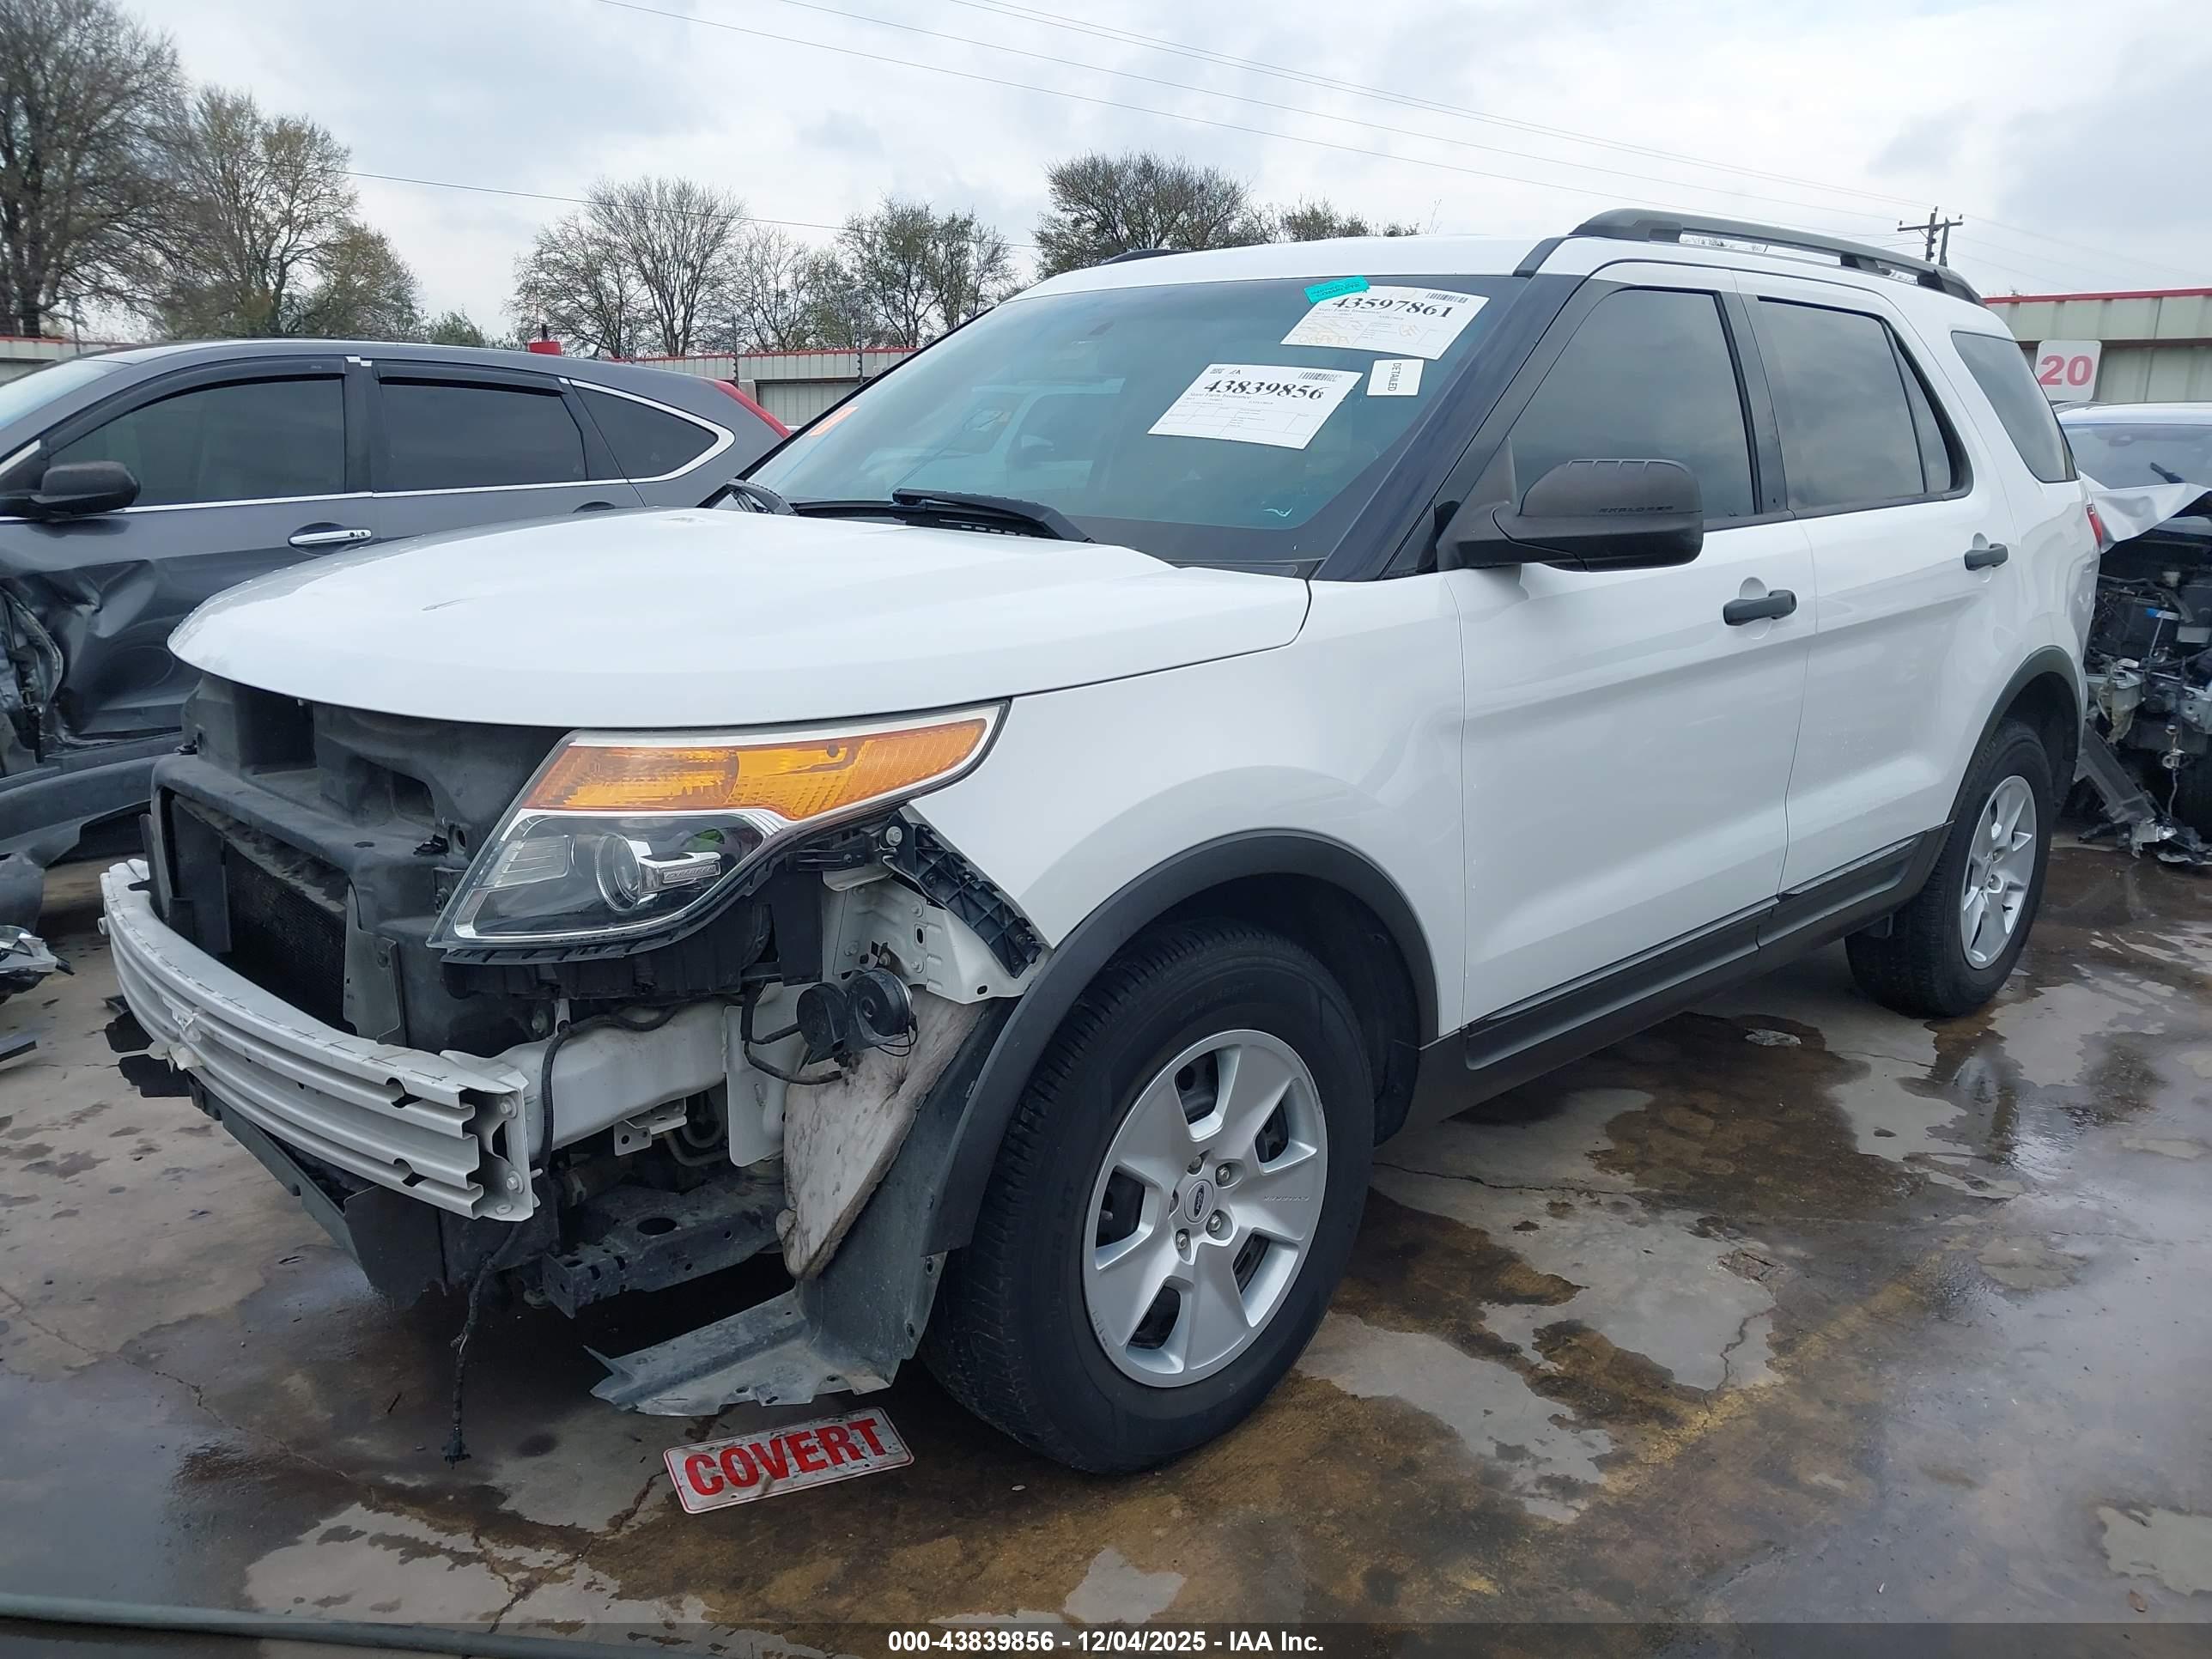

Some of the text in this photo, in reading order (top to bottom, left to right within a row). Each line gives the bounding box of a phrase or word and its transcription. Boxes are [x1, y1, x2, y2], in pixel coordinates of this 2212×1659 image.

[1333, 297, 1454, 318] 43597861
[1388, 362, 1402, 392] DETAILED
[2039, 355, 2094, 386] 20
[1204, 380, 1330, 401] 43839856
[684, 1418, 887, 1497] COVERT
